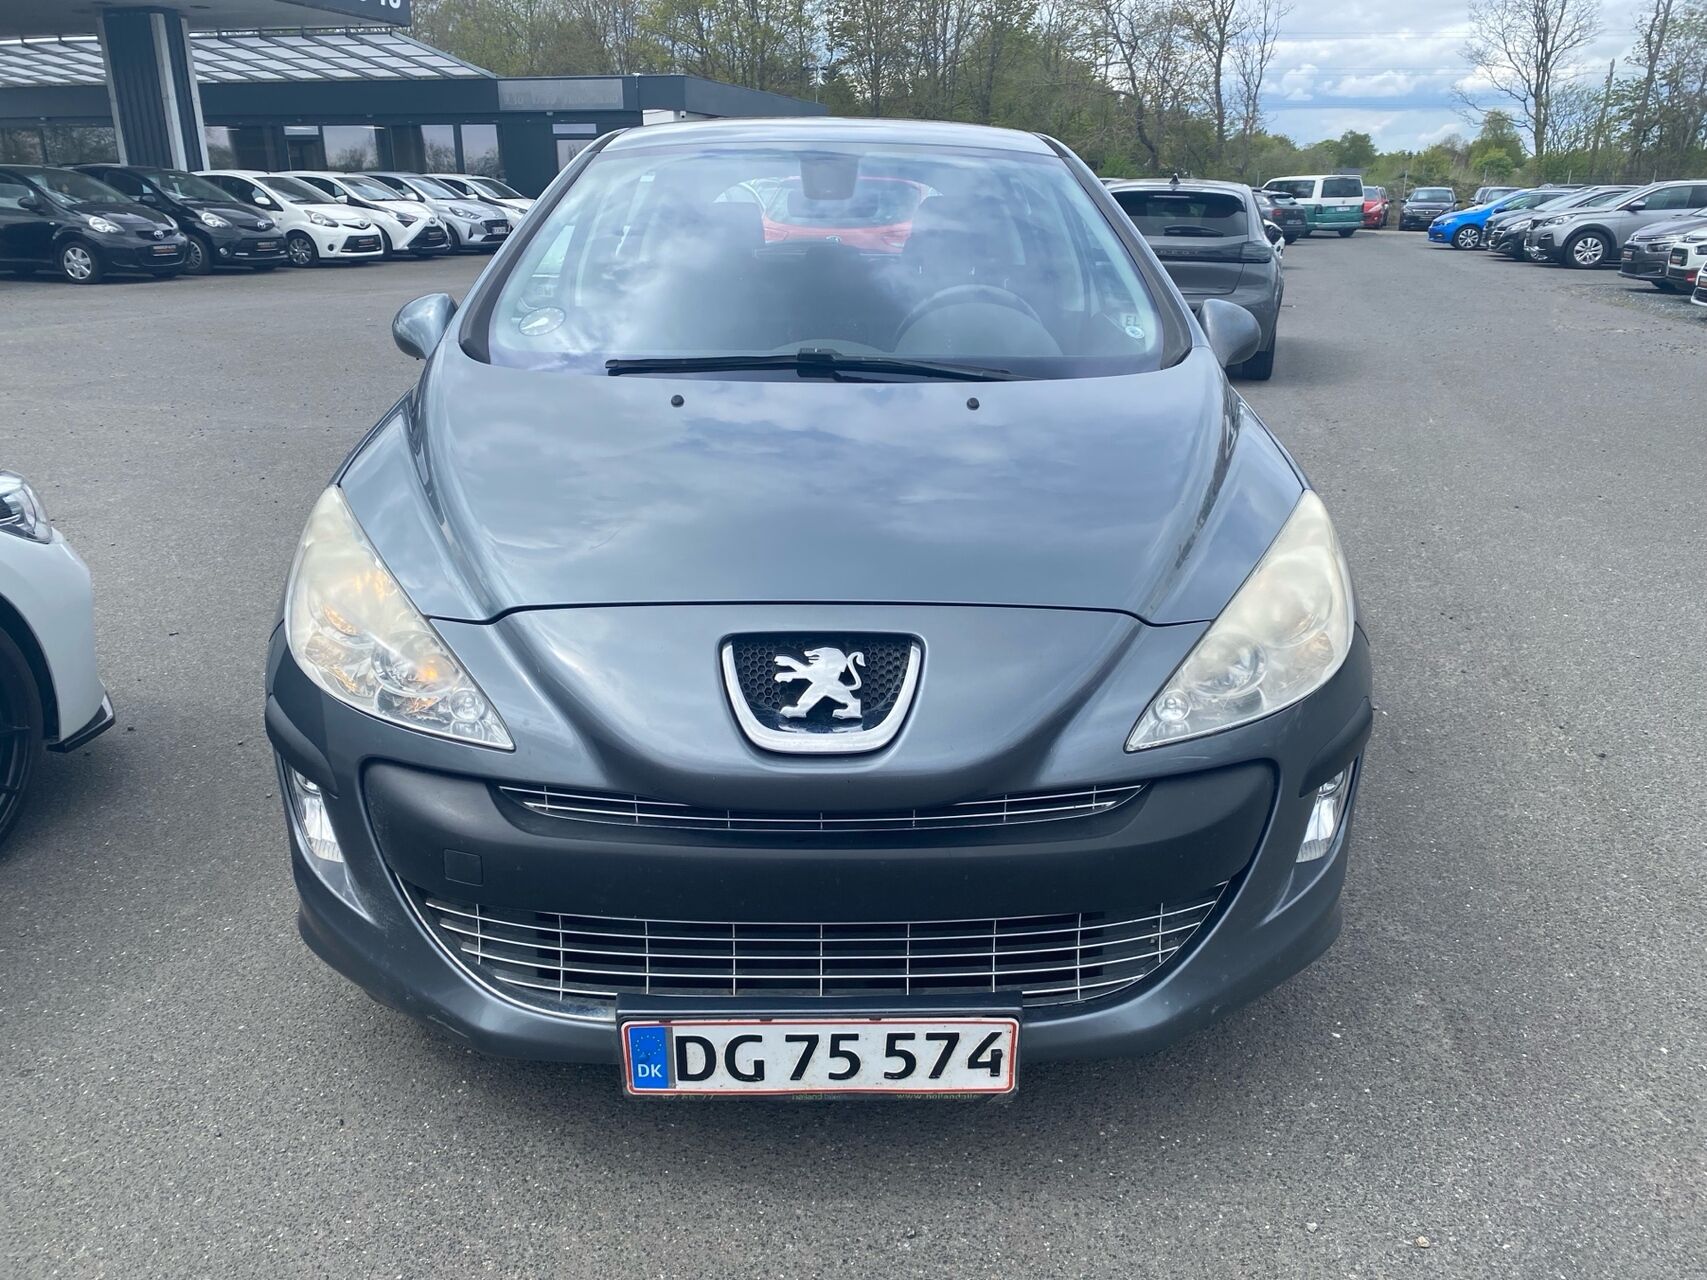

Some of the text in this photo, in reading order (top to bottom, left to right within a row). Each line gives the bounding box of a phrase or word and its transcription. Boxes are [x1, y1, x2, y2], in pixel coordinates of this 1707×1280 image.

[637, 1063, 663, 1078] DK
[675, 1031, 1003, 1082] DG 75 574
